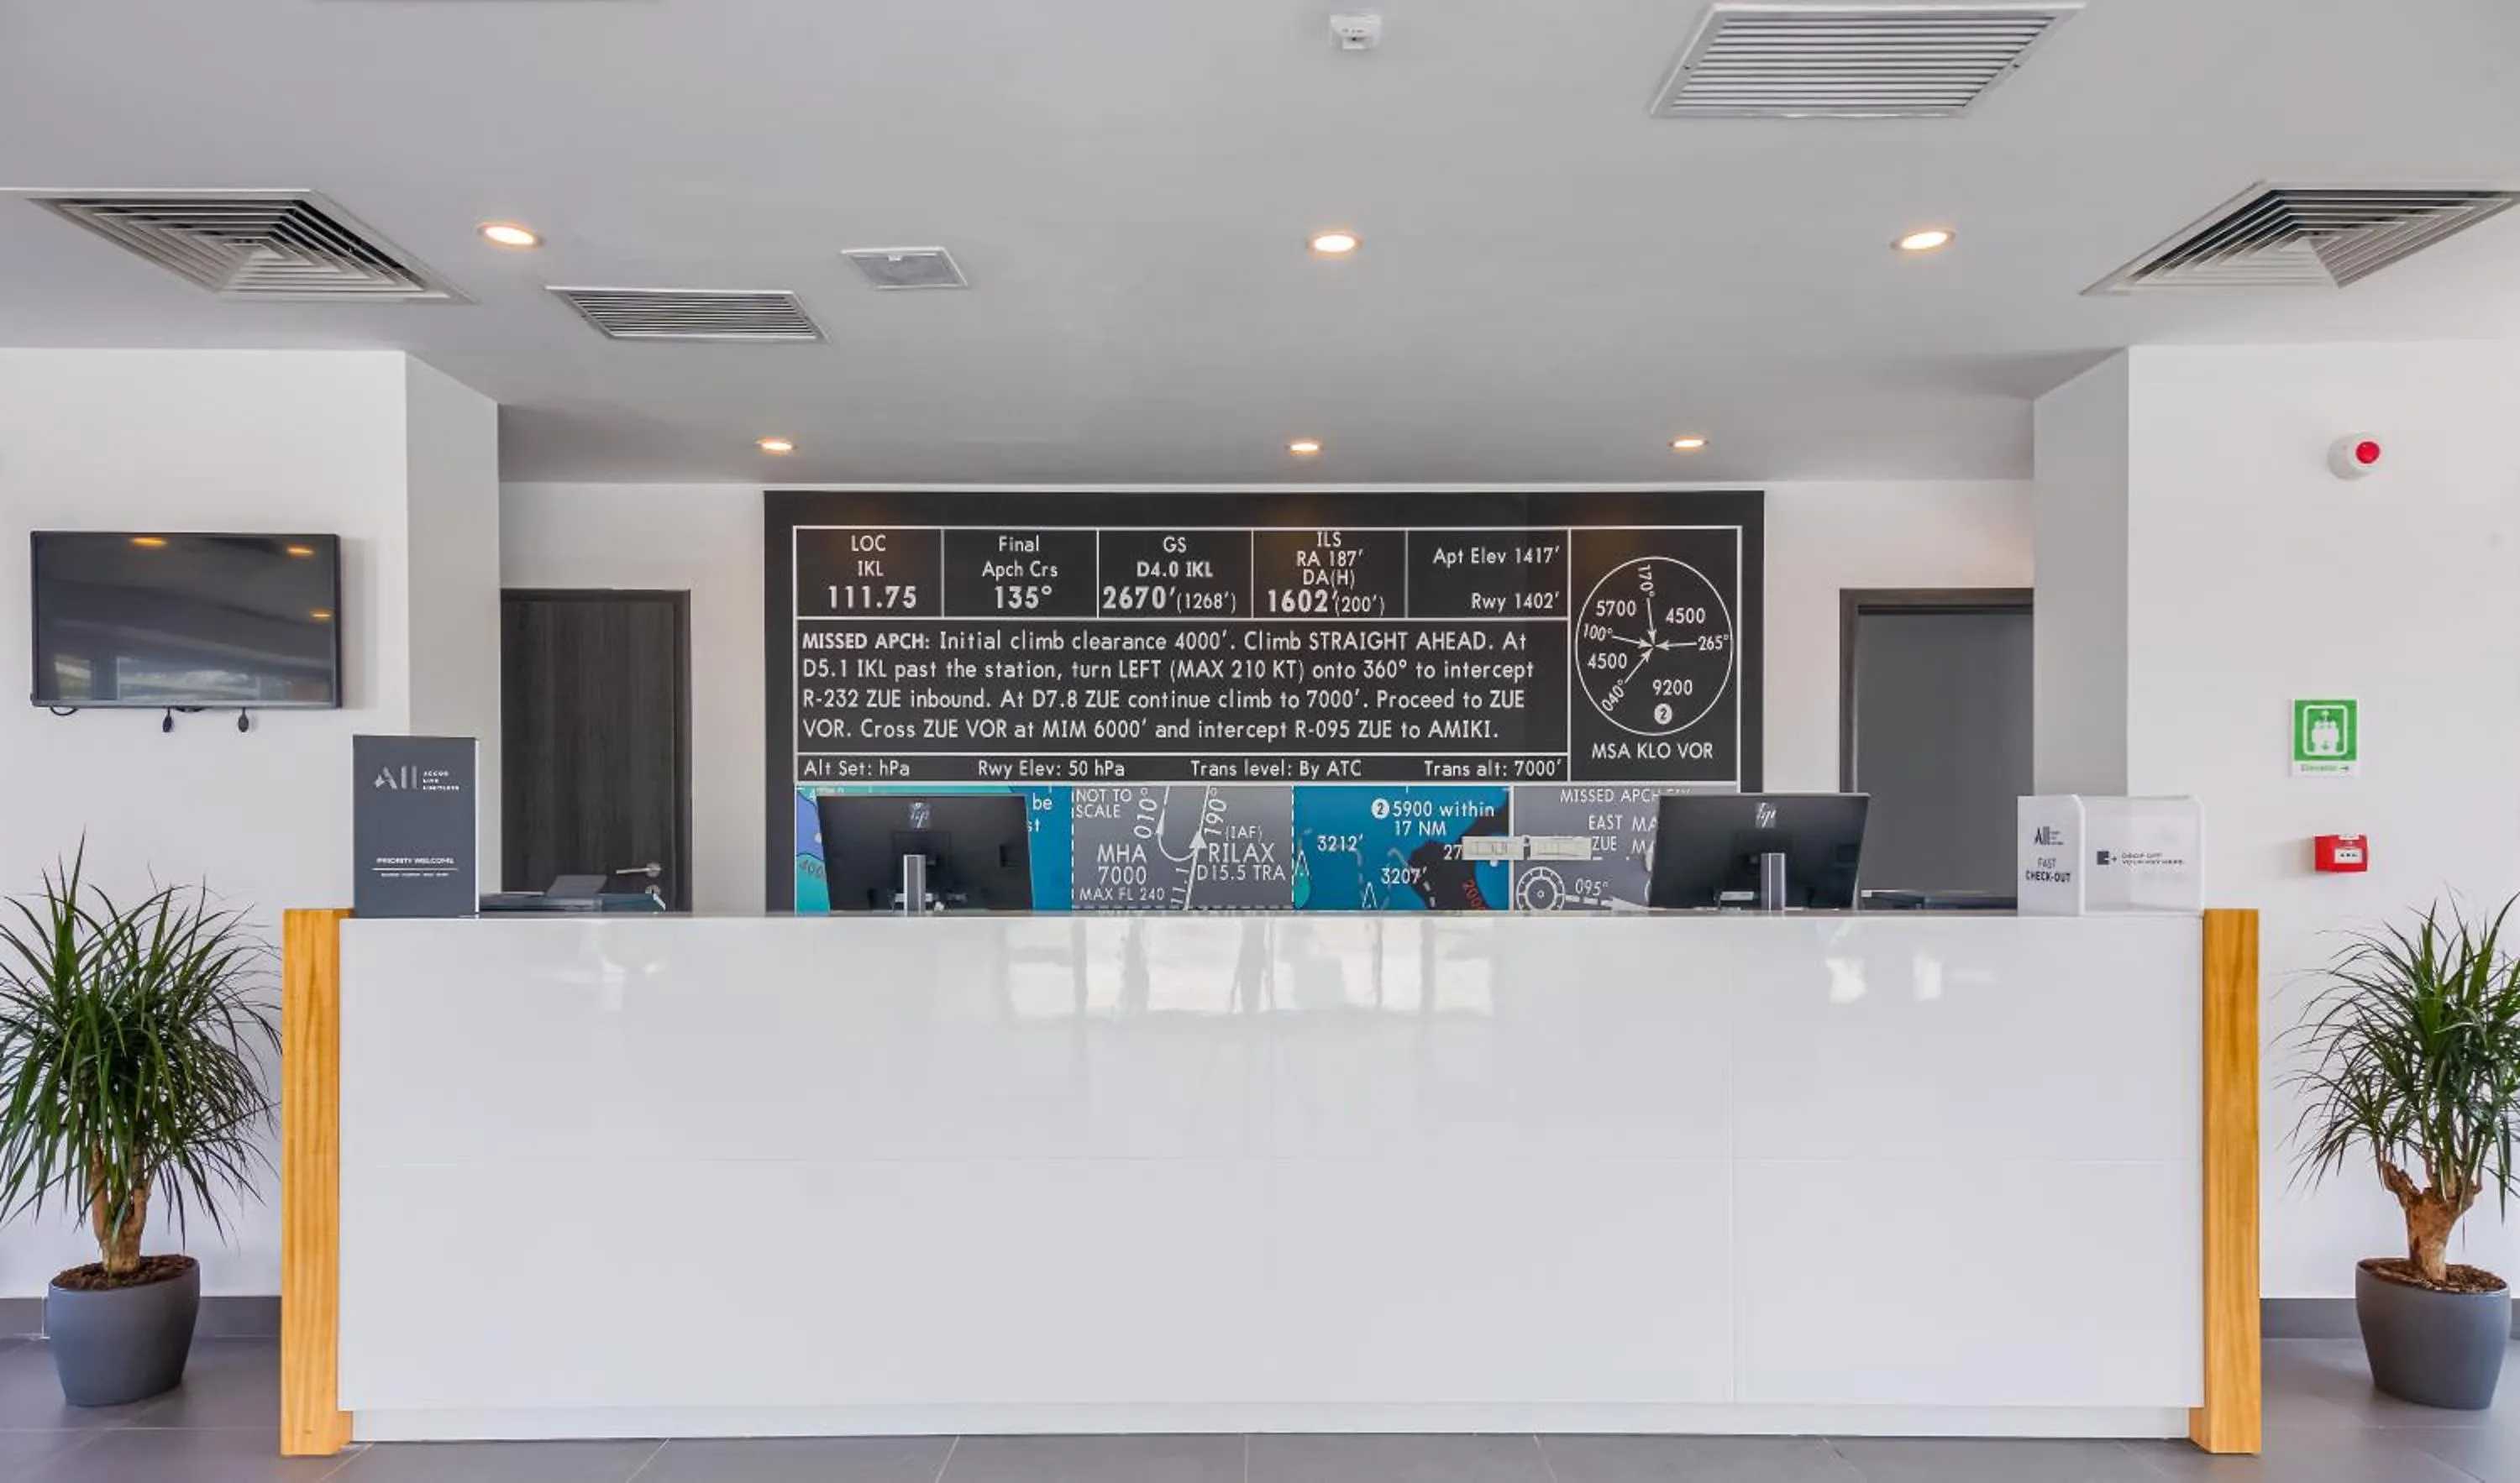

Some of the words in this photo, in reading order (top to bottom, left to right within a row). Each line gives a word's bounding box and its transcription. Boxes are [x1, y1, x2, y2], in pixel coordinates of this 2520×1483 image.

[851, 533, 886, 552] LOC
[999, 534, 1039, 553] Final
[1163, 536, 1187, 553] GS
[1315, 530, 1342, 548] ILS
[1296, 550, 1321, 567] RA
[1330, 548, 1363, 567] 187'
[1432, 548, 1464, 569] Apt
[1471, 547, 1507, 564] Elev
[1515, 545, 1560, 563] 1417'
[858, 560, 884, 577] IKL
[981, 559, 1024, 582] Apch
[1029, 560, 1058, 578] Crs
[1137, 560, 1179, 578] D4.0
[1185, 561, 1214, 578] IKL
[1303, 569, 1355, 589] DA(H)
[828, 585, 916, 609] 111.75
[995, 585, 1053, 609] 135°
[1471, 592, 1506, 613] Rwy
[1515, 590, 1560, 610] 1402'
[1595, 600, 1637, 617] 5700
[1665, 607, 1706, 624] 4500
[802, 632, 868, 649] MISSED
[874, 632, 930, 650] APCH:
[940, 629, 1001, 650] Initial
[1010, 629, 1064, 650] climb
[1071, 630, 1167, 651] clearance
[1174, 629, 1236, 650] 4000'.
[1244, 630, 1301, 651] Climb
[1309, 631, 1409, 651] STRAIGHT
[1415, 631, 1494, 651] AHEAD.
[1502, 631, 1526, 651] At
[1587, 652, 1628, 669] 4500
[803, 658, 847, 678] D5.1
[857, 658, 887, 678] IKL
[895, 661, 937, 683] past
[946, 658, 977, 679] the
[984, 659, 1063, 681] station,
[1071, 661, 1111, 679] turn
[1119, 659, 1162, 679] LEFT
[1170, 659, 1224, 683] (MAX
[1231, 659, 1266, 679] 210
[1273, 659, 1305, 684] KT)
[1312, 661, 1357, 679] onto
[1363, 658, 1407, 679] 360°
[1415, 661, 1436, 679] to
[1444, 660, 1534, 684] intercept
[1652, 679, 1693, 696] 9200
[803, 688, 859, 708] R-232
[866, 689, 901, 708] ZUE
[911, 687, 991, 709] inbound.
[1000, 689, 1024, 708] At
[1032, 689, 1078, 709] D7.8
[1084, 689, 1120, 709] ZUE
[1128, 689, 1210, 709] continue
[1218, 688, 1273, 709] climb
[1279, 691, 1299, 709] to
[1306, 688, 1368, 709] 7000'.
[1377, 688, 1455, 709] Proceed
[1462, 691, 1483, 709] to
[1489, 689, 1525, 709] ZUE
[802, 718, 852, 738] VOR.
[860, 718, 916, 738] Cross
[923, 718, 958, 738] ZUE
[965, 718, 1007, 738] VOR
[1014, 721, 1034, 738] at
[1042, 719, 1087, 738] MIM
[1094, 717, 1147, 738] 6000'
[1155, 718, 1190, 738] and
[1198, 720, 1287, 743] intercept
[1294, 720, 1350, 738] R-095
[1357, 720, 1392, 739] ZUE
[1400, 721, 1420, 739] to
[1427, 720, 1499, 738] AMIKI.
[1592, 742, 1631, 760] MSA
[1637, 742, 1672, 760] KLO
[1677, 742, 1713, 759] VOR
[803, 758, 832, 777] Alt
[838, 760, 872, 777] Set:
[879, 758, 911, 777] hPa
[978, 759, 1013, 780] Rwy
[1019, 758, 1061, 777] Elev:
[1068, 759, 1088, 777] 50
[1095, 758, 1125, 777] hPa
[1190, 760, 1237, 777] Trans
[1244, 758, 1292, 777] level:
[1299, 760, 1320, 780] By
[1326, 758, 1362, 777] ATC
[1424, 760, 1471, 777] Trans
[1476, 759, 1507, 777] alt:
[1514, 758, 1562, 777] 7000'
[1032, 792, 1053, 810] be
[1075, 789, 1107, 802] NOT
[1112, 789, 1132, 802] TO
[1560, 788, 1614, 804] MISSED
[1075, 804, 1121, 819] SCALE
[1392, 800, 1432, 818] 5900
[1439, 800, 1495, 818] within
[1394, 820, 1412, 836] 17
[1419, 820, 1447, 836] NM
[1588, 814, 1624, 831] EAST
[1096, 843, 1147, 863] MHA
[1208, 842, 1275, 863] RILAX
[1592, 836, 1618, 852] ZUE
[1097, 866, 1147, 884] 7000
[1196, 864, 1246, 881] D15.5
[1252, 864, 1287, 881] TRA
[1079, 887, 1113, 901] MAX
[1118, 887, 1133, 901] FL
[1139, 887, 1165, 901] 240
